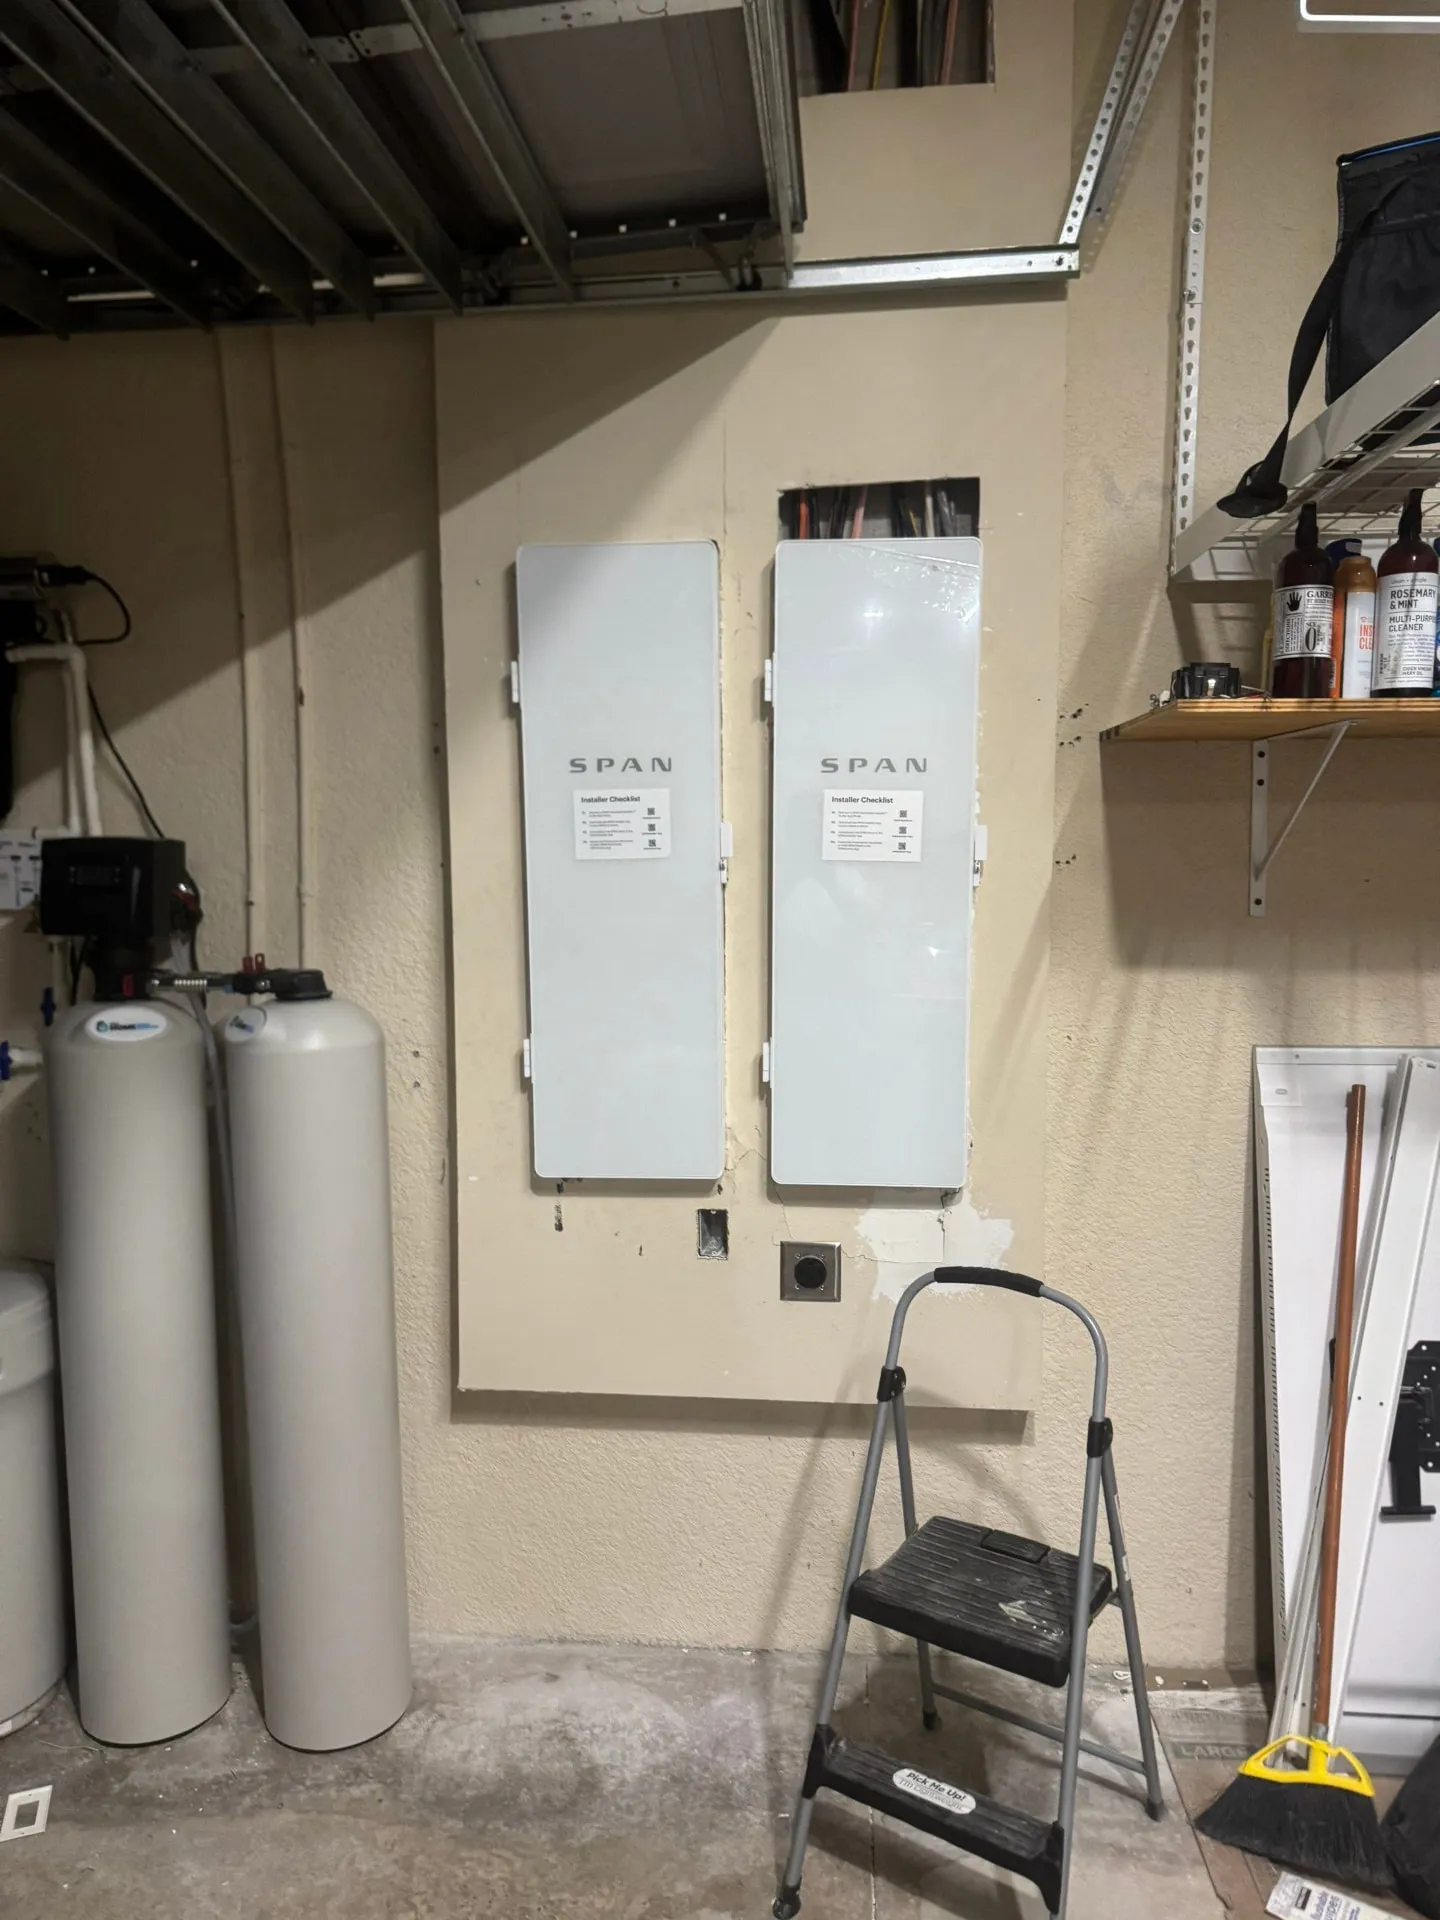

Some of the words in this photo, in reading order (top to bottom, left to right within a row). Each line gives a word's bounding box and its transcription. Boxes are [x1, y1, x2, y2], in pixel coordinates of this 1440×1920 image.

[1390, 588, 1436, 599] ROSEMARY
[1390, 600, 1397, 610] &
[1398, 599, 1418, 609] MINT
[1388, 623, 1424, 632] CLEANER
[569, 757, 672, 773] SPAN
[820, 757, 927, 773] SPAN
[580, 796, 608, 804] Installer
[609, 795, 641, 803] Checklist
[861, 796, 894, 804] Checklist
[906, 1771, 928, 1785] Pick
[929, 1782, 946, 1793] Me
[946, 1789, 967, 1802] Up!
